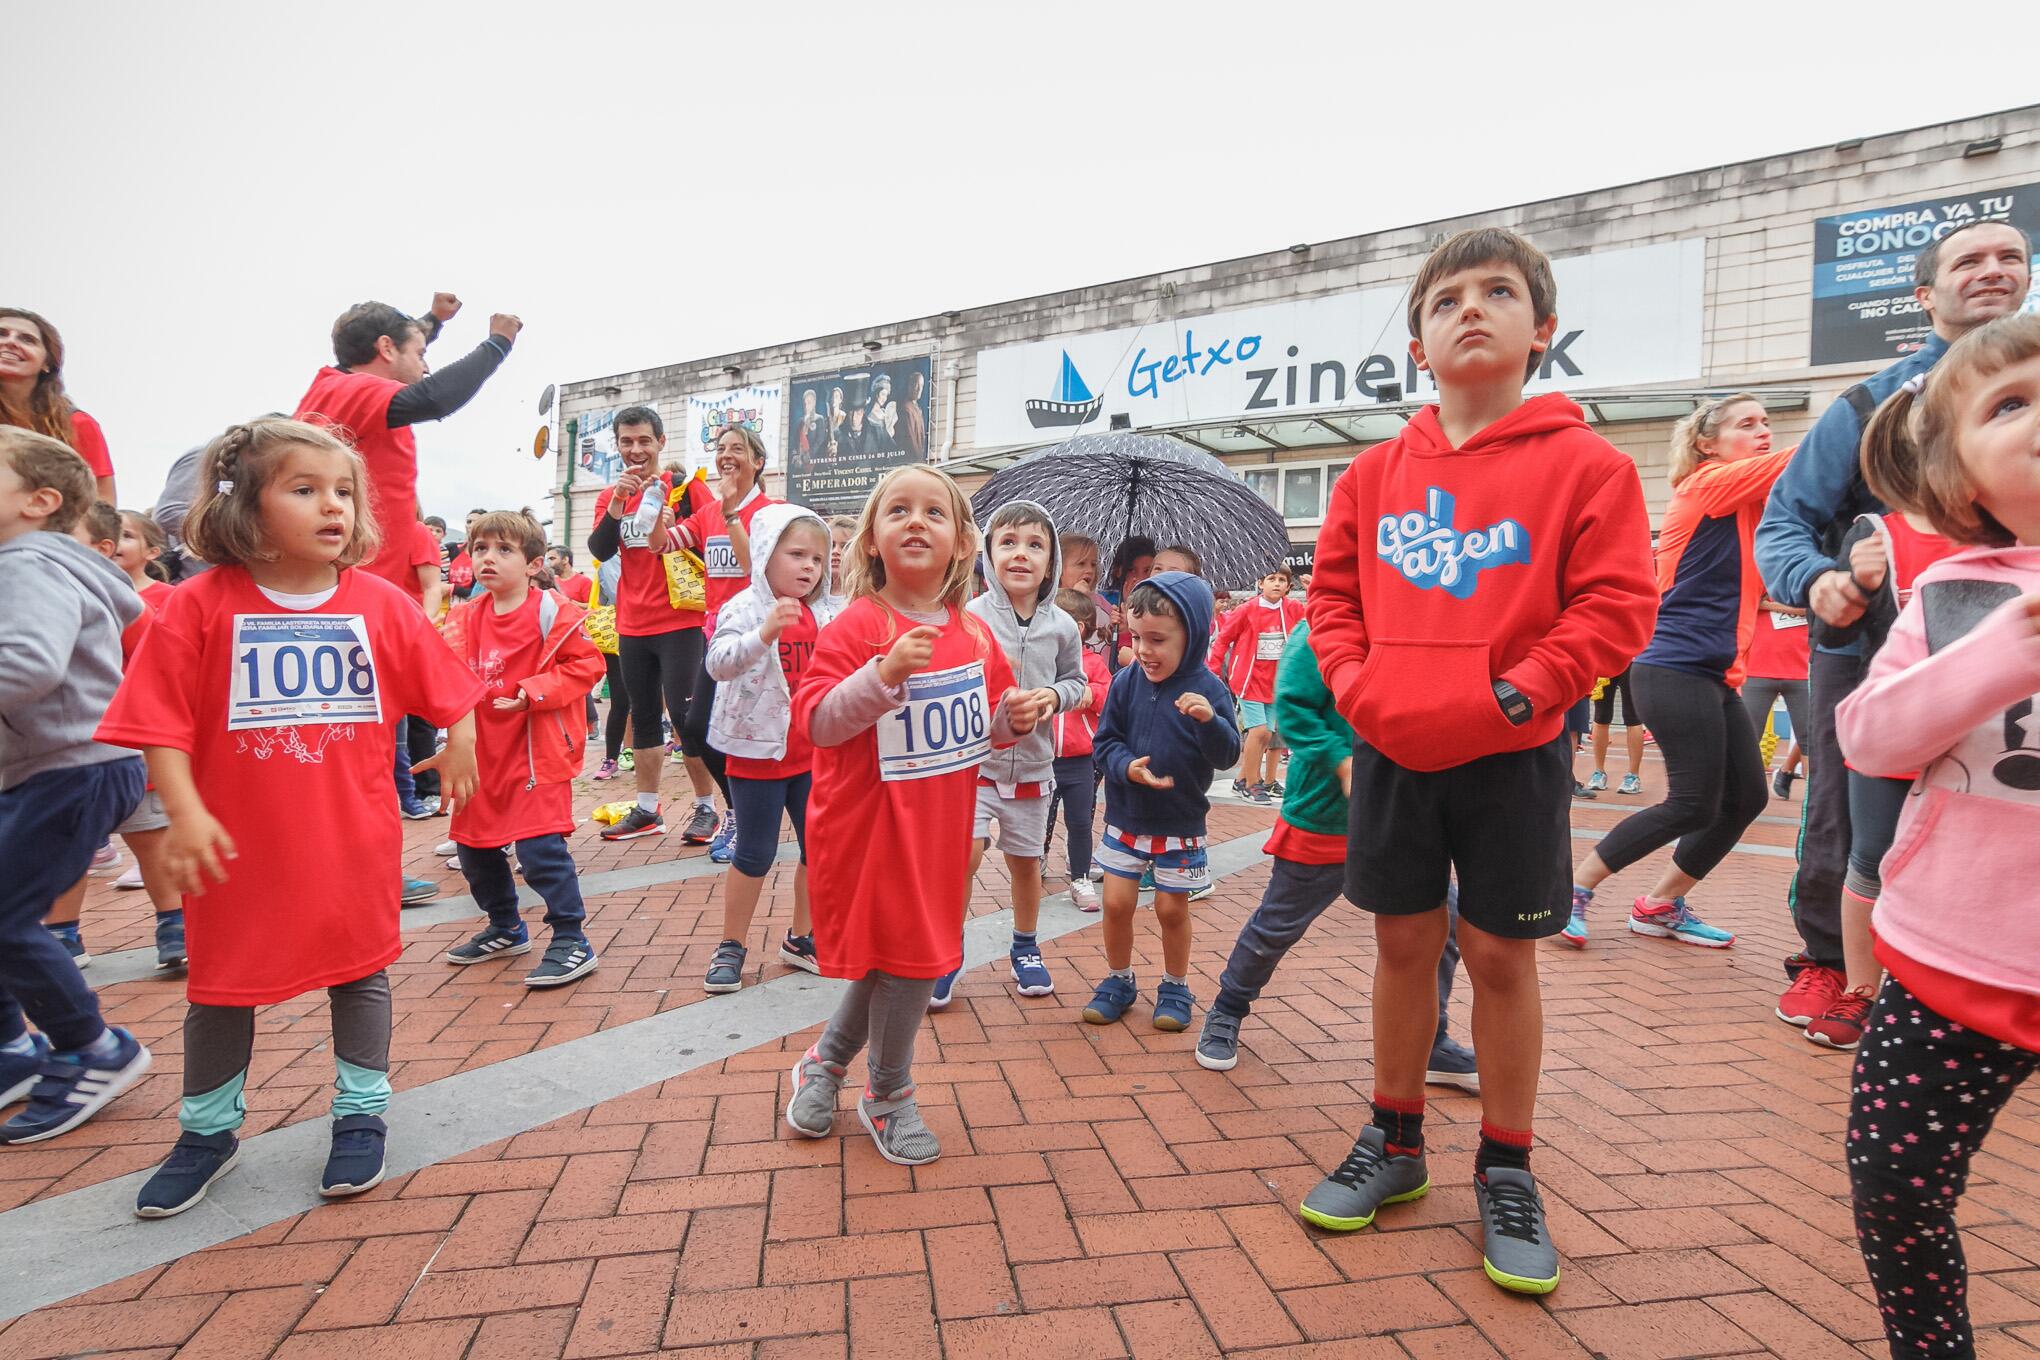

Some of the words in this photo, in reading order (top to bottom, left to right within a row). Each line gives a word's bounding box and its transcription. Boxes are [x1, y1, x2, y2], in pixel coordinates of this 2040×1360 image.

[1838, 208, 1936, 237] COMPRA
[1942, 202, 1975, 221] YA
[1979, 195, 2014, 215] TU
[1836, 212, 2010, 258] BONOC
[1835, 267, 1895, 282] CUALQUIER
[1836, 259, 1885, 273] DISFRUTA
[1868, 276, 1907, 288] SESIÓN
[1847, 298, 1891, 311] CUANDO
[1128, 330, 1262, 399] Getxo
[848, 454, 867, 462] CINES
[886, 450, 906, 459] JULIO
[802, 475, 868, 492] EMPERADOR
[1377, 488, 1440, 564] Go!
[1402, 520, 1517, 587] azen
[240, 645, 375, 698] 1008
[895, 691, 984, 753] 1008
[1518, 909, 1552, 921] KIPSTA
